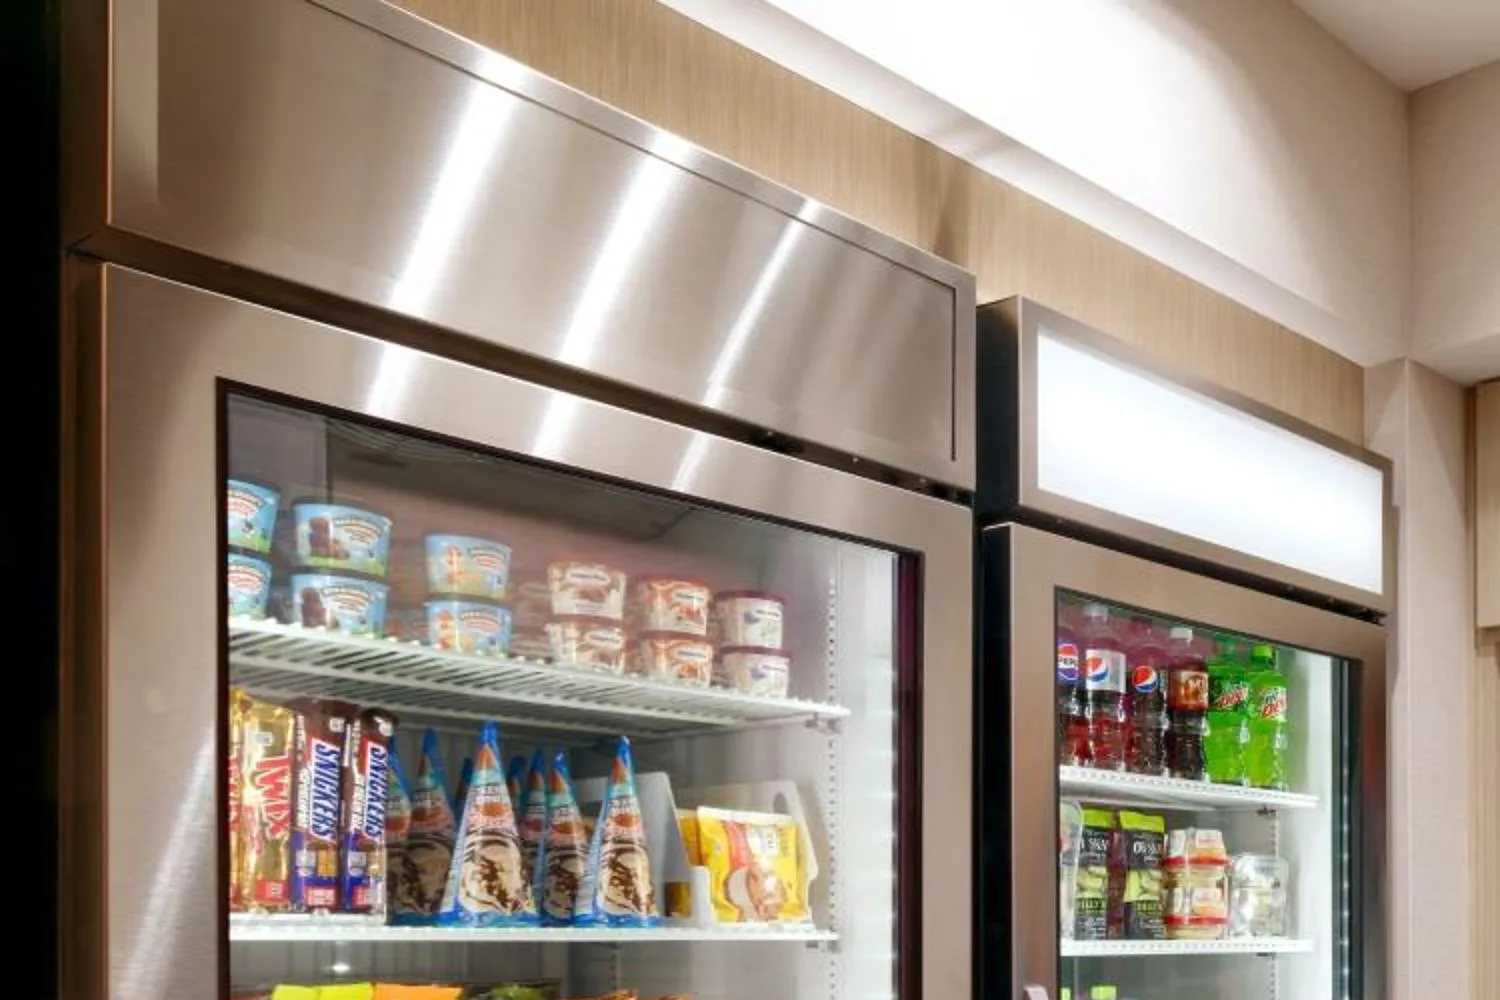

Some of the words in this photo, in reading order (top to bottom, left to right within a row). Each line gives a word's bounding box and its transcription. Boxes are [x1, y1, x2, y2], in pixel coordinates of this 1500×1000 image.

[256, 754, 293, 839] TWIX
[312, 742, 341, 838] SNICKERS
[365, 744, 389, 838] SNICKERS
